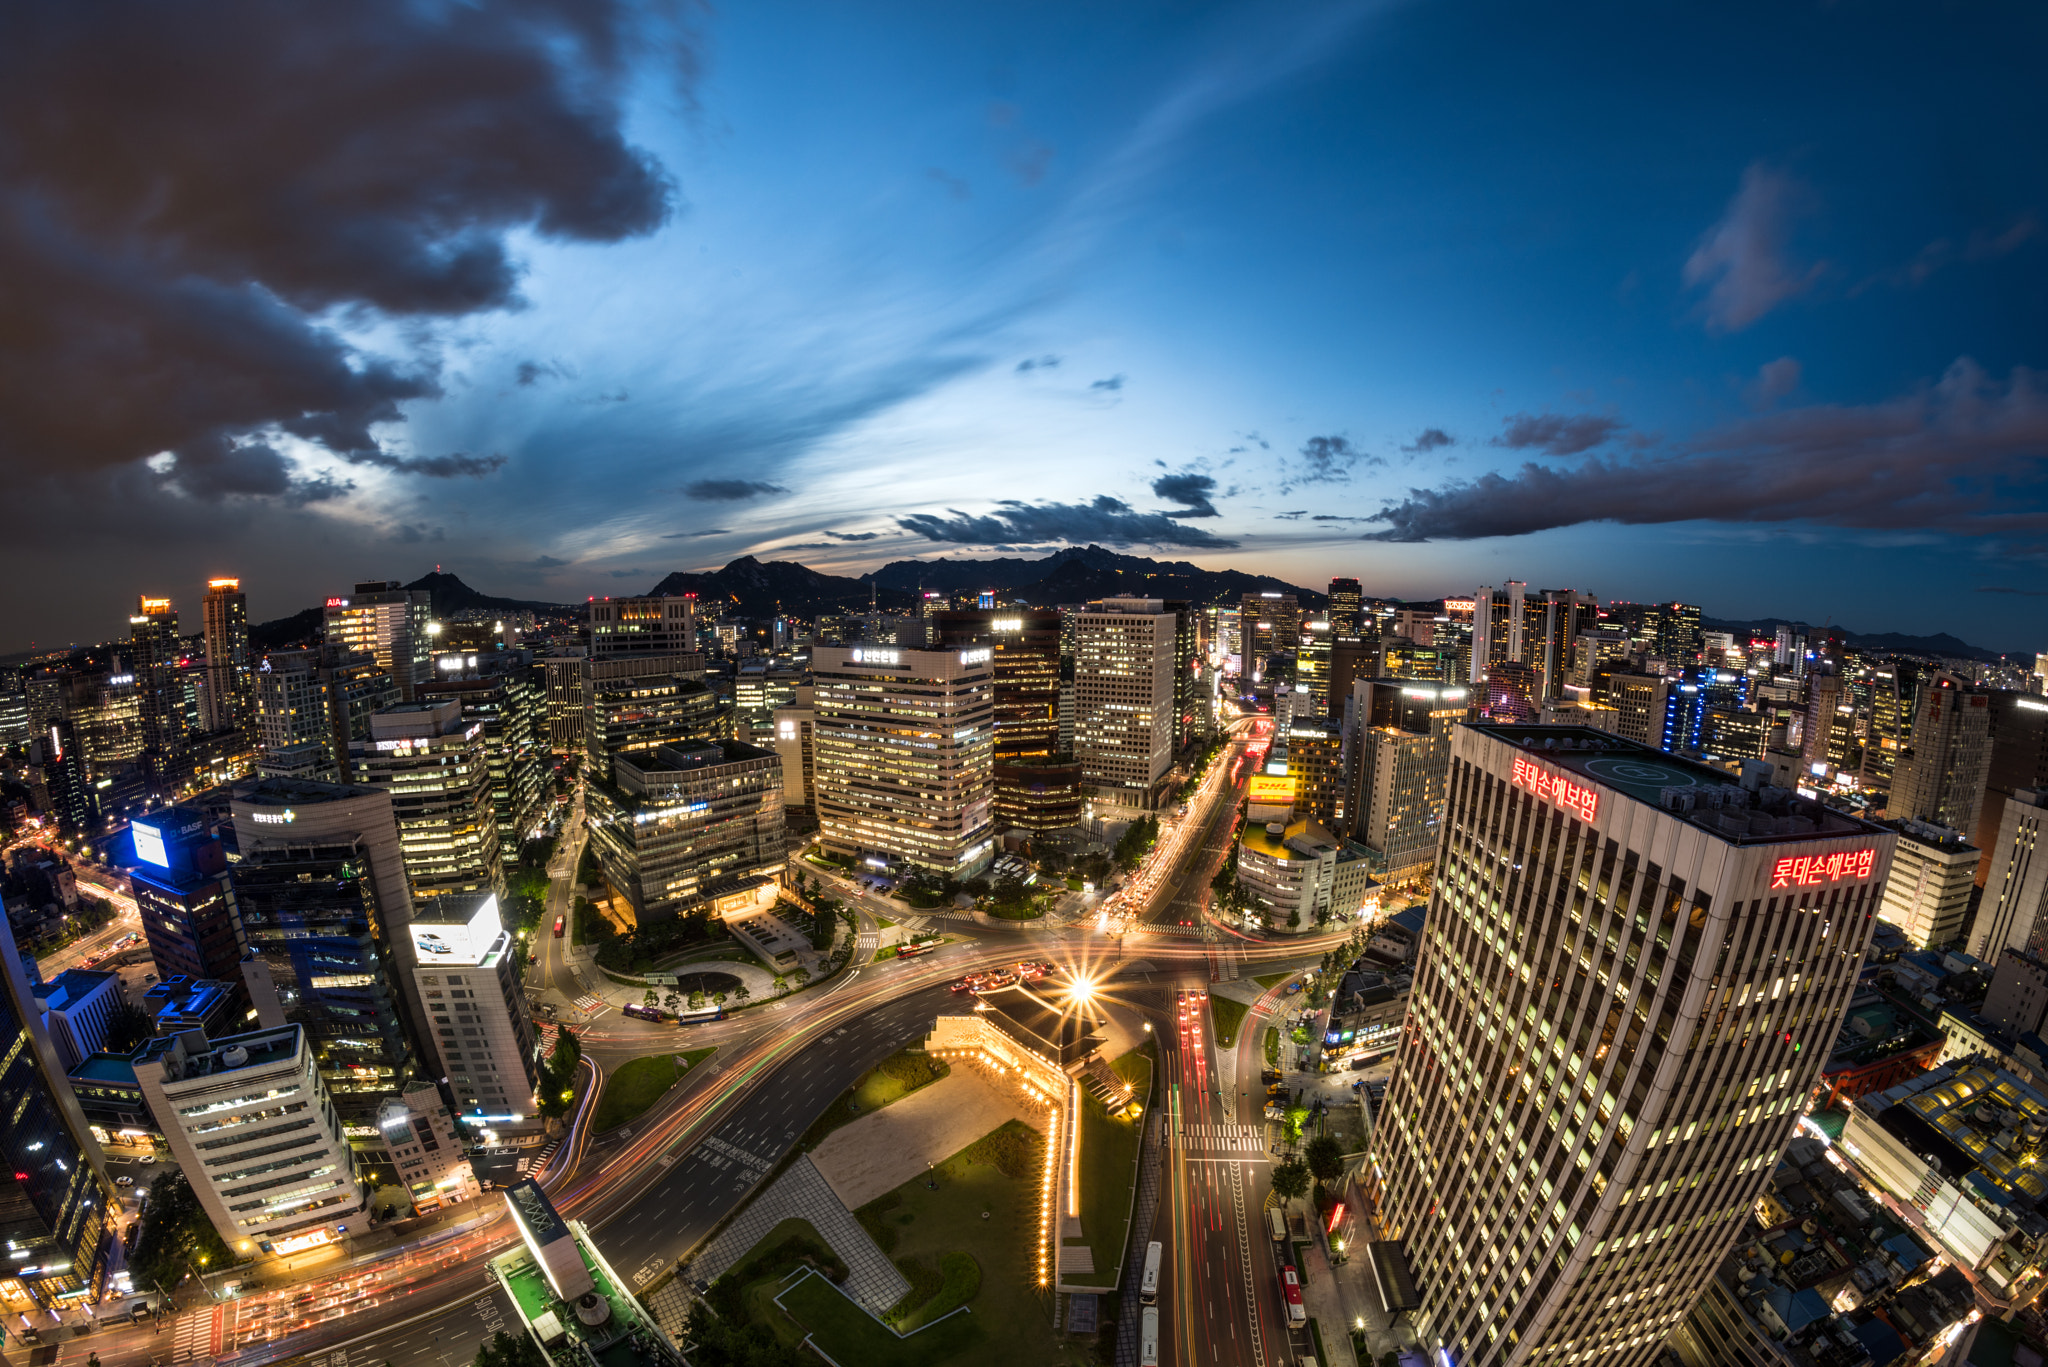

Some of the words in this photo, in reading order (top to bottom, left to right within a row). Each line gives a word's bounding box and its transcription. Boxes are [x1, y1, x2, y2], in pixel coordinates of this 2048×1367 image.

[327, 598, 341, 607] AIA
[863, 650, 899, 664] 신한은행
[376, 740, 401, 750] HSBC
[1511, 757, 1598, 823] 롯데손해보험
[181, 820, 203, 834] BASF
[1771, 849, 1875, 889] 롯데손해보험
[474, 1295, 493, 1310] 50
[480, 1306, 499, 1321] 50
[485, 1318, 505, 1332] 50
